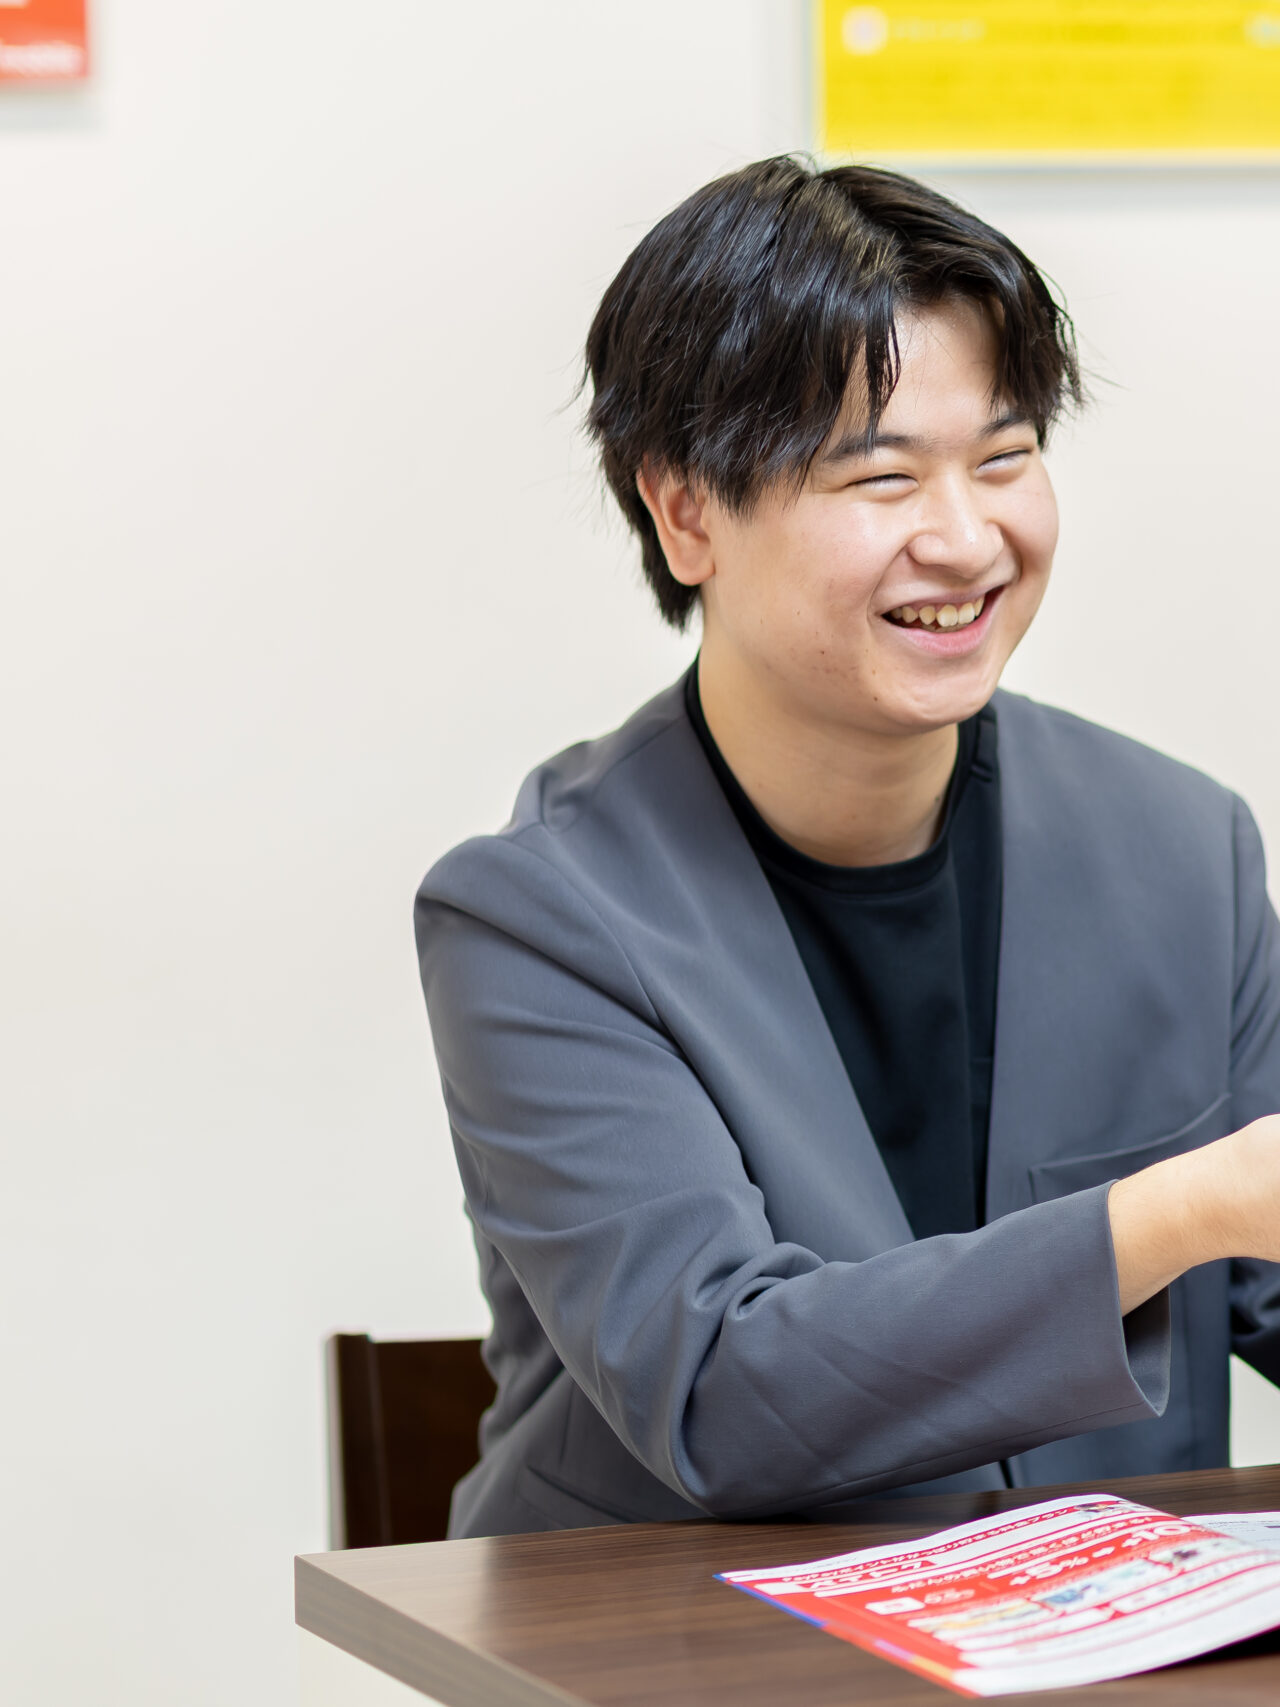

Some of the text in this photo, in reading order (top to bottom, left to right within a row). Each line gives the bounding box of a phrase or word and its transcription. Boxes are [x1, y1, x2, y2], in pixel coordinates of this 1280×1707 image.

[809, 1561, 922, 1589] ペイトク
[1009, 1556, 1090, 1586] +5%
